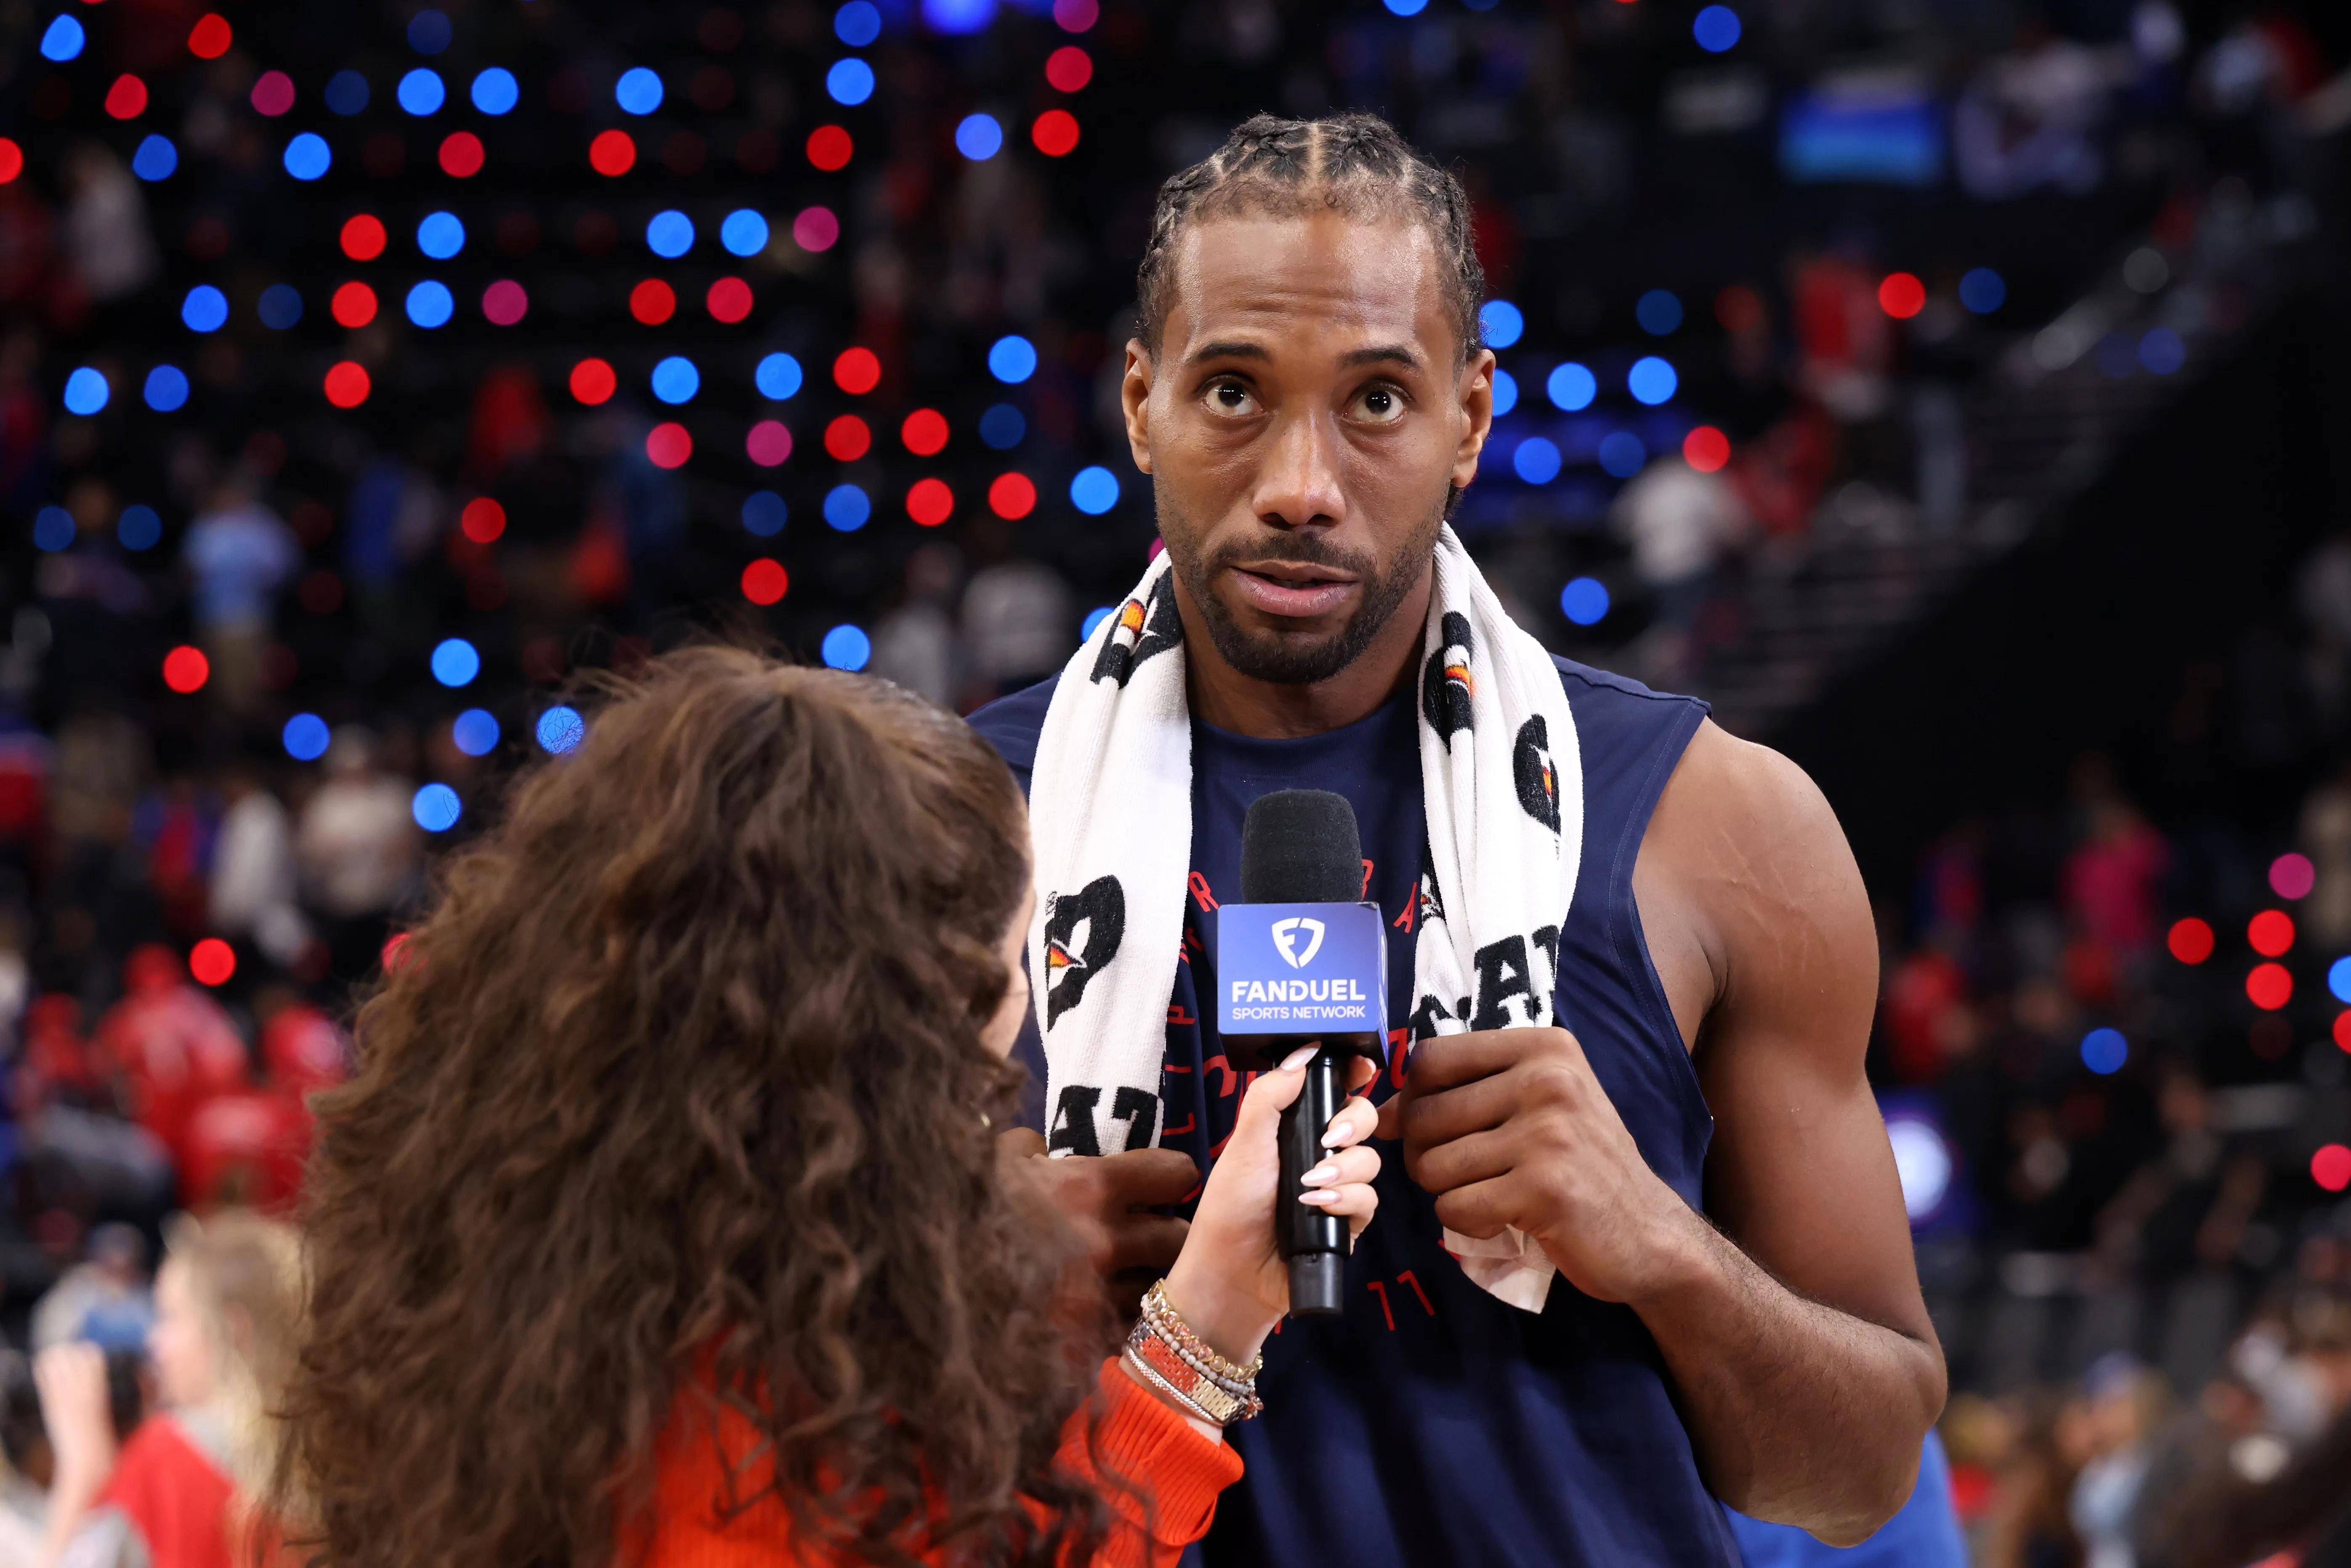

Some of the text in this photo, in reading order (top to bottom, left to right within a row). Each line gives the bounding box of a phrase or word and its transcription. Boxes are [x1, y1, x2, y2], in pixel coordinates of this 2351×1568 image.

[1232, 979, 1366, 1003] FANDUEL
[1232, 1005, 1366, 1020] SPORTS NETWORK
